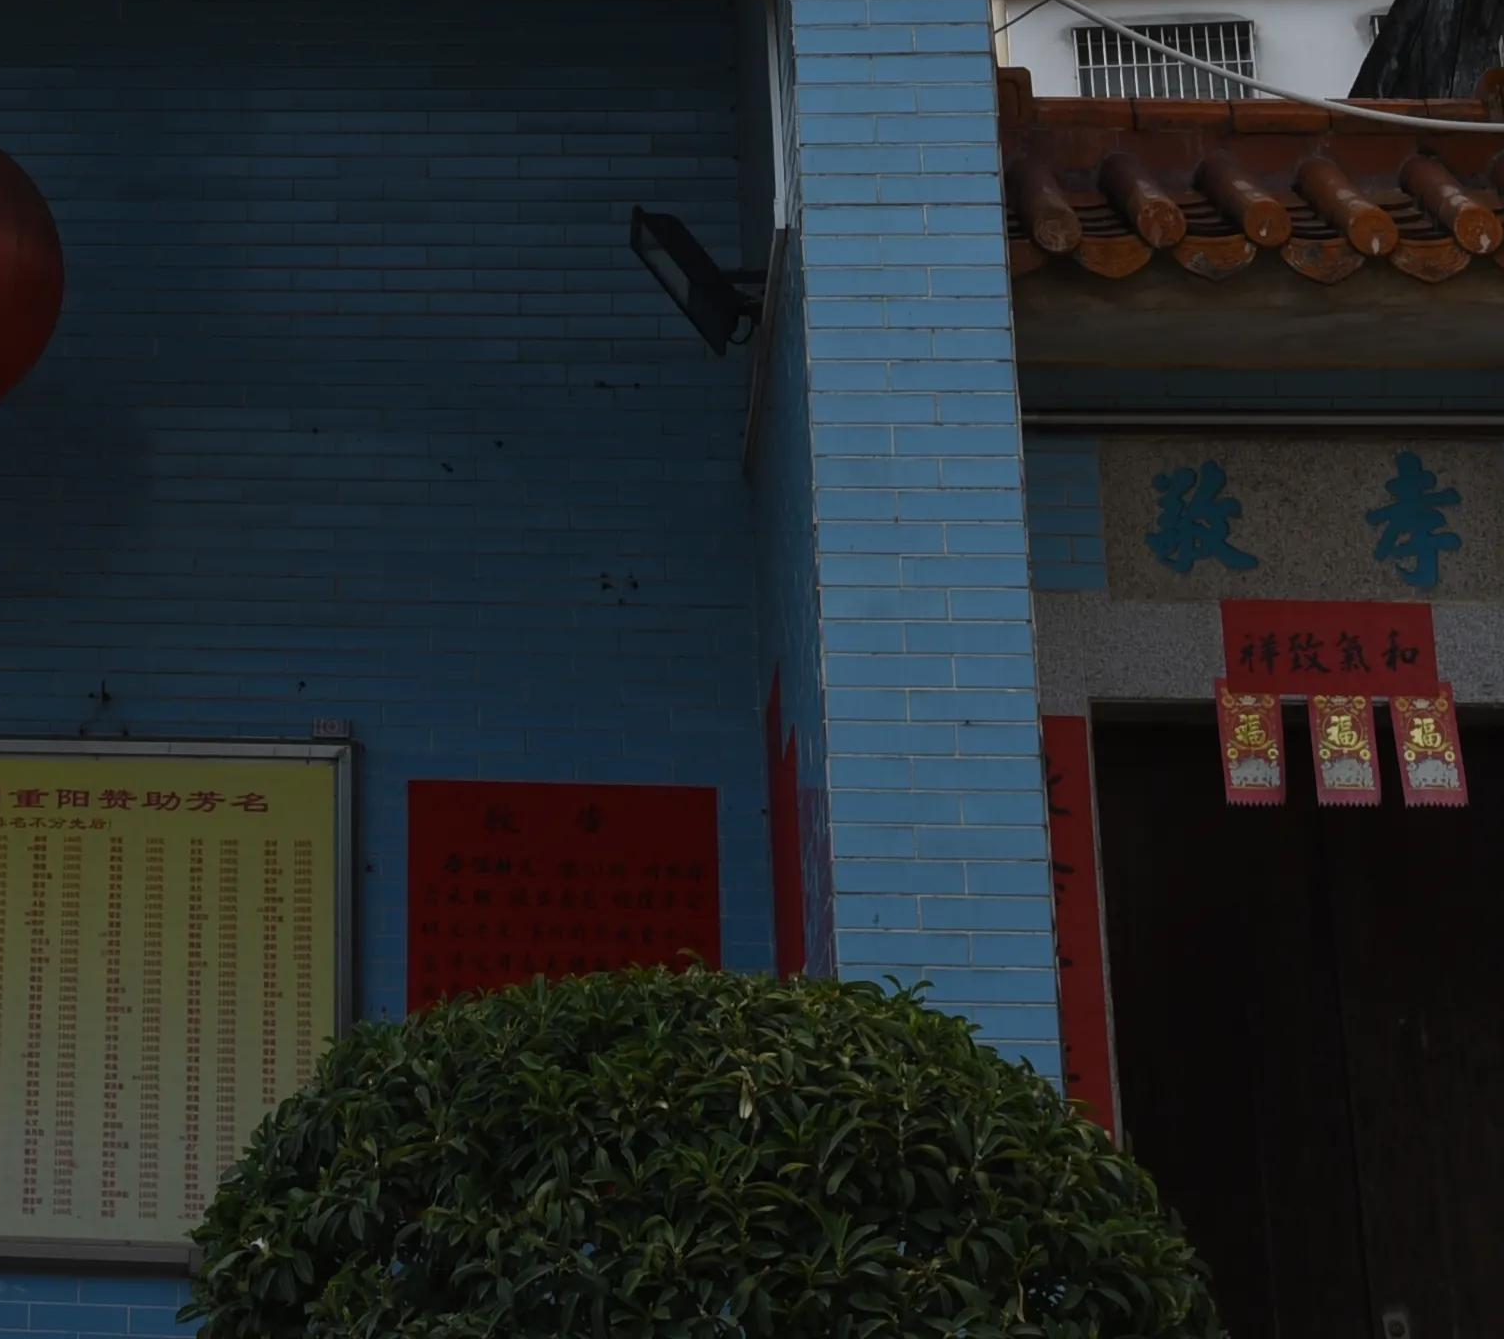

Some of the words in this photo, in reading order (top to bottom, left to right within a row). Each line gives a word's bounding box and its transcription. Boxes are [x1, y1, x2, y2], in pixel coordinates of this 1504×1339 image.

[1234, 714, 1267, 746] 福
[1326, 714, 1359, 747] 福
[1409, 717, 1443, 749] 福
